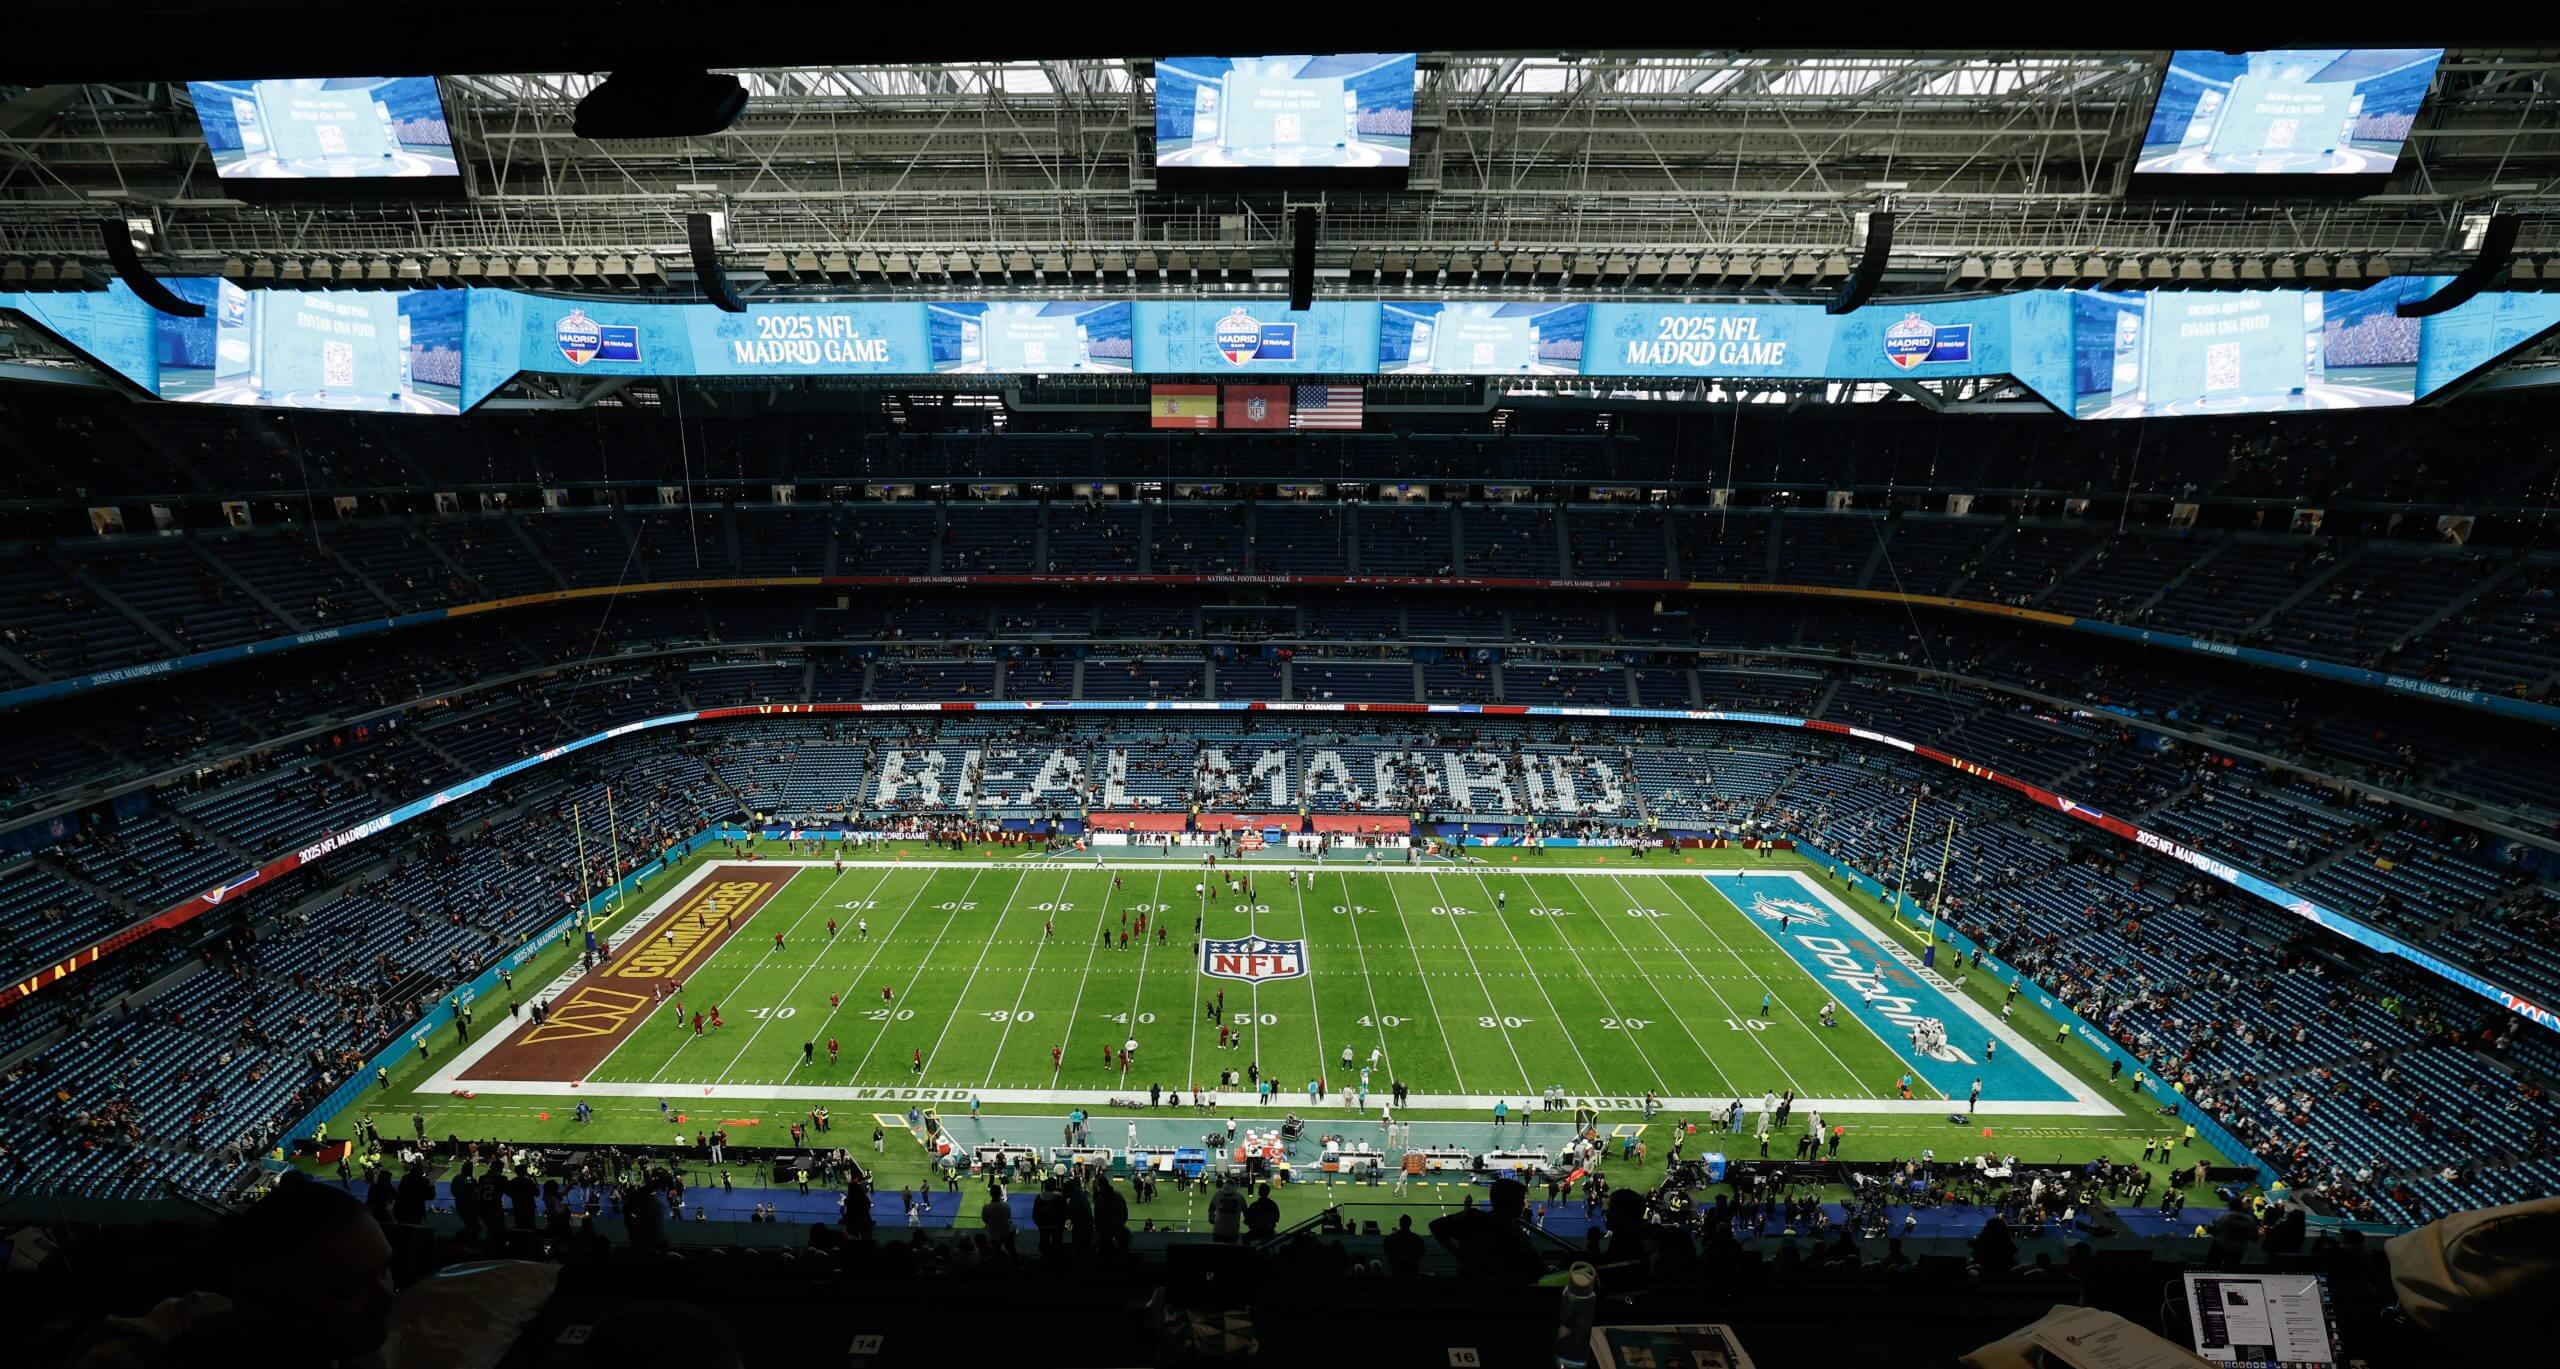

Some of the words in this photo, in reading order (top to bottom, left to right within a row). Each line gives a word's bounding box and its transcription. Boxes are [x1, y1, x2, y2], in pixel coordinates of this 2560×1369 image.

[757, 315, 814, 339] 2025
[817, 315, 859, 339] NFL
[1658, 316, 1715, 340] 2025
[1719, 317, 1761, 341] NFL
[559, 334, 598, 344] MADRID
[1218, 334, 1257, 343] MADRID
[1887, 338, 1931, 348] MADRID
[734, 340, 821, 365] MADRID
[825, 340, 889, 363] GAME
[1627, 340, 1716, 366] MADRID
[1719, 342, 1786, 366] GAME
[1249, 407, 1266, 418] NFL
[1207, 575, 1235, 583] NATIONAL
[1237, 575, 1267, 583] FOOTBALL
[1268, 575, 1291, 583] LEAGUE
[150, 660, 172, 676] GAME
[2418, 682, 2451, 699] MADRID
[2449, 687, 2475, 703] GAME
[874, 749, 1163, 808] REAL
[1196, 749, 1627, 814] MADRID
[299, 844, 322, 864] 2025
[320, 837, 339, 855] NFL
[337, 823, 368, 847] MADRID
[365, 814, 392, 834] GAME
[2136, 829, 2158, 848] 2025
[2157, 837, 2175, 857] NFL
[2173, 846, 2210, 872] MADRID
[2209, 861, 2238, 883] GAME
[617, 881, 759, 978] COMMANDERS
[513, 948, 528, 965] 2025
[527, 941, 538, 956] NFL
[536, 928, 558, 950] MADRID
[1215, 954, 1295, 977] NFL
[1879, 940, 1909, 958] END
[1907, 959, 1958, 994] RACISM
[753, 1007, 796, 1019] 10
[869, 1009, 915, 1021] 20
[990, 1010, 1035, 1022] 30
[1111, 1012, 1156, 1024] 40
[1233, 1013, 1278, 1025] 50
[1356, 1015, 1400, 1027] 40
[1478, 1016, 1524, 1028] 30
[1600, 1017, 1645, 1030] 20
[1725, 1018, 1766, 1031] 10
[2085, 1030, 2111, 1054] Santander
[856, 1088, 970, 1101] MADRID
[568, 1329, 588, 1339] 13
[857, 1339, 877, 1351] 14
[1455, 1350, 1475, 1363] 16
